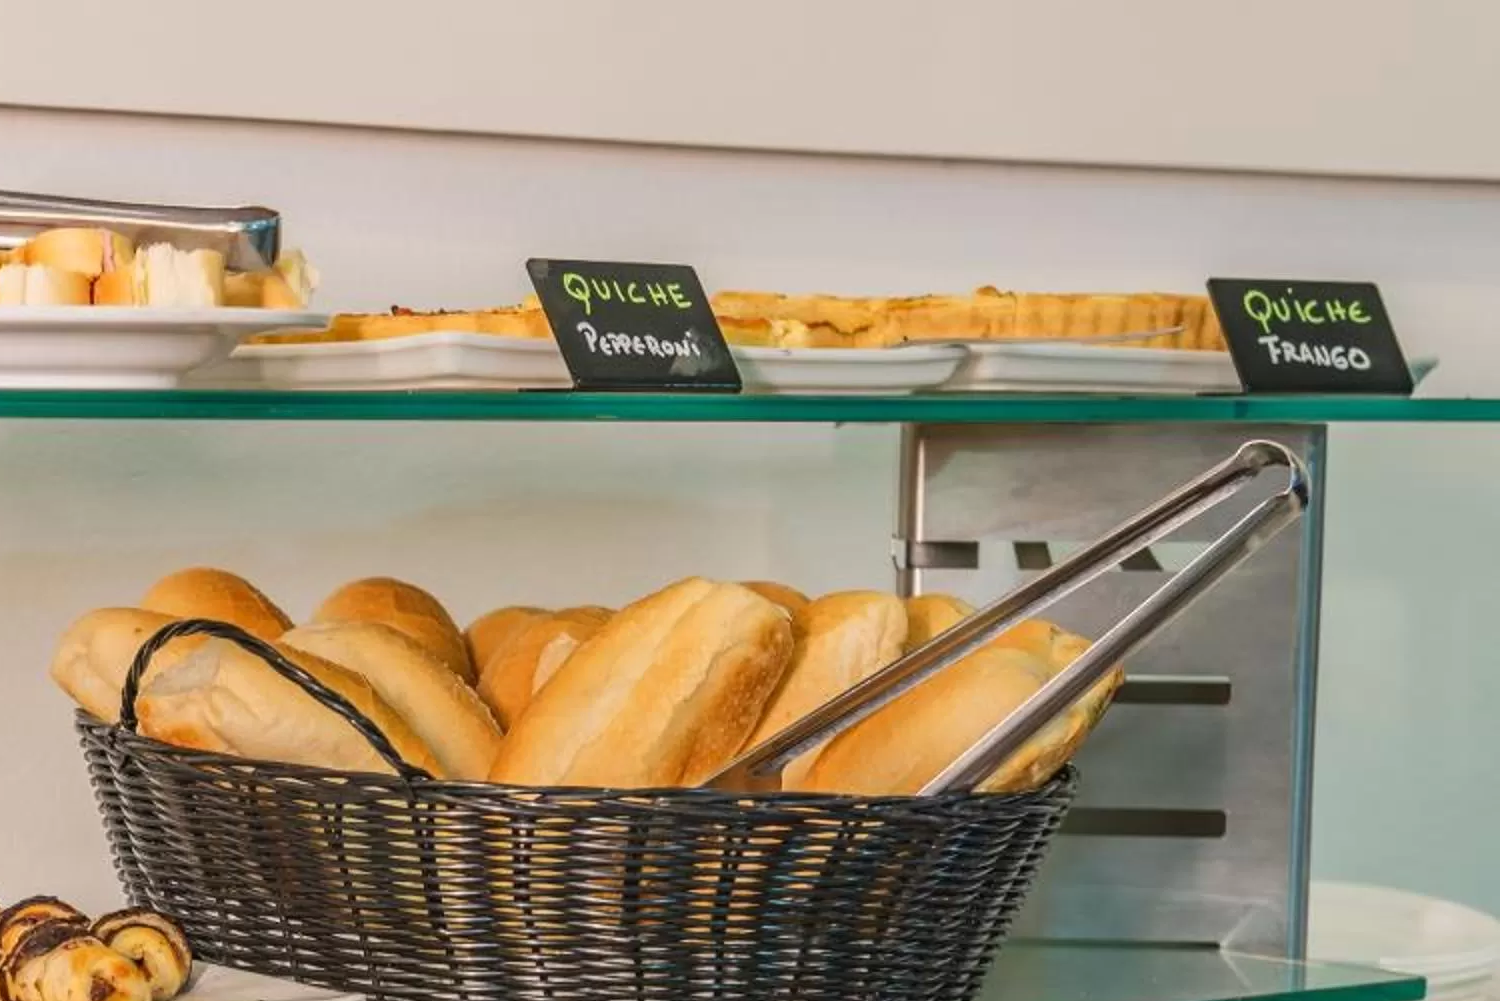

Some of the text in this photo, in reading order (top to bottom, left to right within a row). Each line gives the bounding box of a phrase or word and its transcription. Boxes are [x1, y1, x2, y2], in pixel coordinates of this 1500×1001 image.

[563, 272, 693, 315] QUICHE
[1243, 288, 1372, 334] QUICHE
[576, 321, 701, 359] PEPPERONI
[1257, 334, 1372, 370] FRANGO
